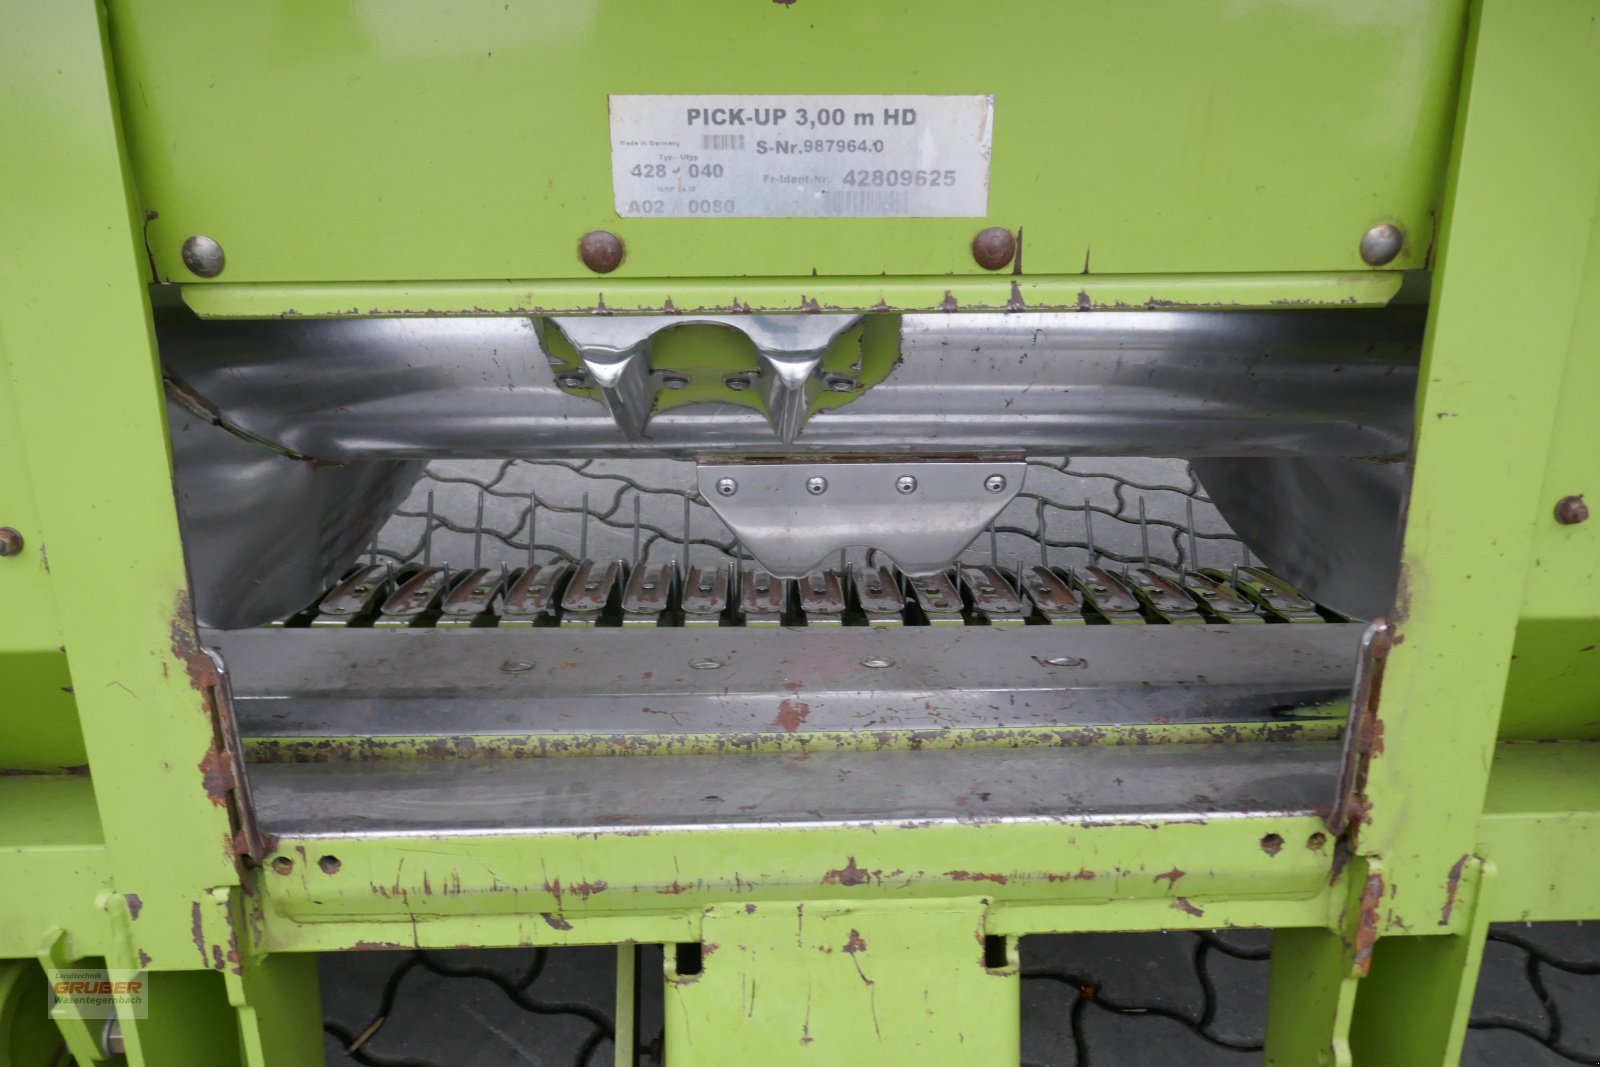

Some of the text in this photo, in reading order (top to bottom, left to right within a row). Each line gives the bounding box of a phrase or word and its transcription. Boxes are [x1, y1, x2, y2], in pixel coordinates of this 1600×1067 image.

[687, 108, 917, 129] PICK-UP 3,00 m HD
[649, 140, 681, 148] Germany
[630, 163, 667, 178] 428
[688, 163, 724, 178] 040
[841, 169, 956, 187] 42809625
[627, 199, 735, 214] A02 0080
